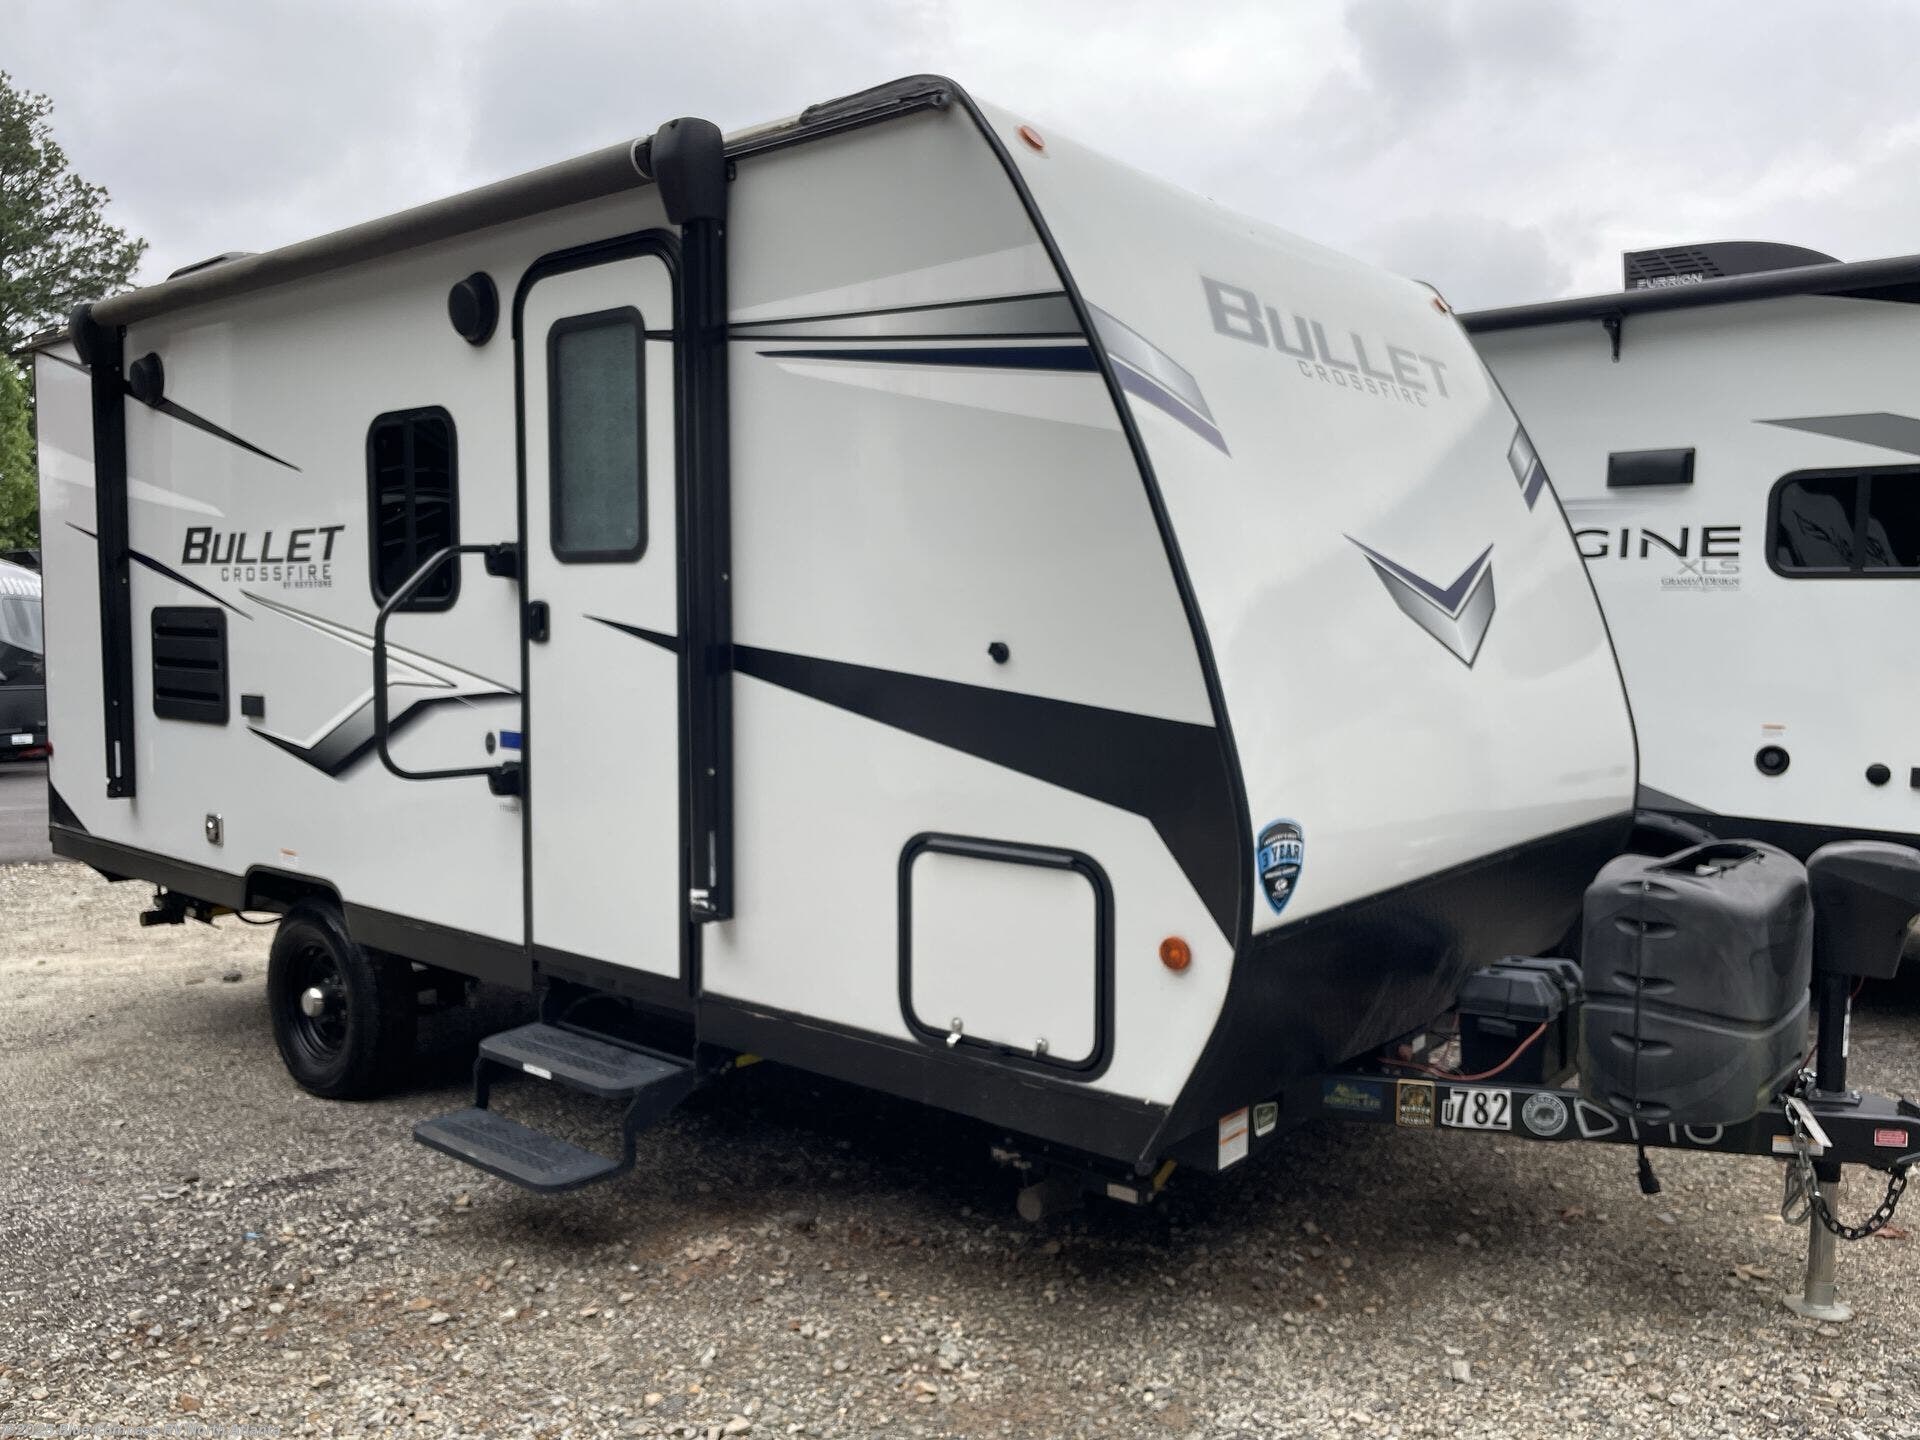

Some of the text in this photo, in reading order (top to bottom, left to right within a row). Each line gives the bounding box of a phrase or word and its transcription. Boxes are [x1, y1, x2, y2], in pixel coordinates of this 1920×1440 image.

[1637, 273, 1703, 289] FURRION
[1200, 274, 1449, 398] BULLET
[1296, 360, 1428, 408] CROSSFIRE
[181, 525, 346, 565] BULLET
[221, 564, 332, 582] CROSSFIRE
[1679, 560, 1740, 575] XLS
[1271, 843, 1300, 862] YEAR
